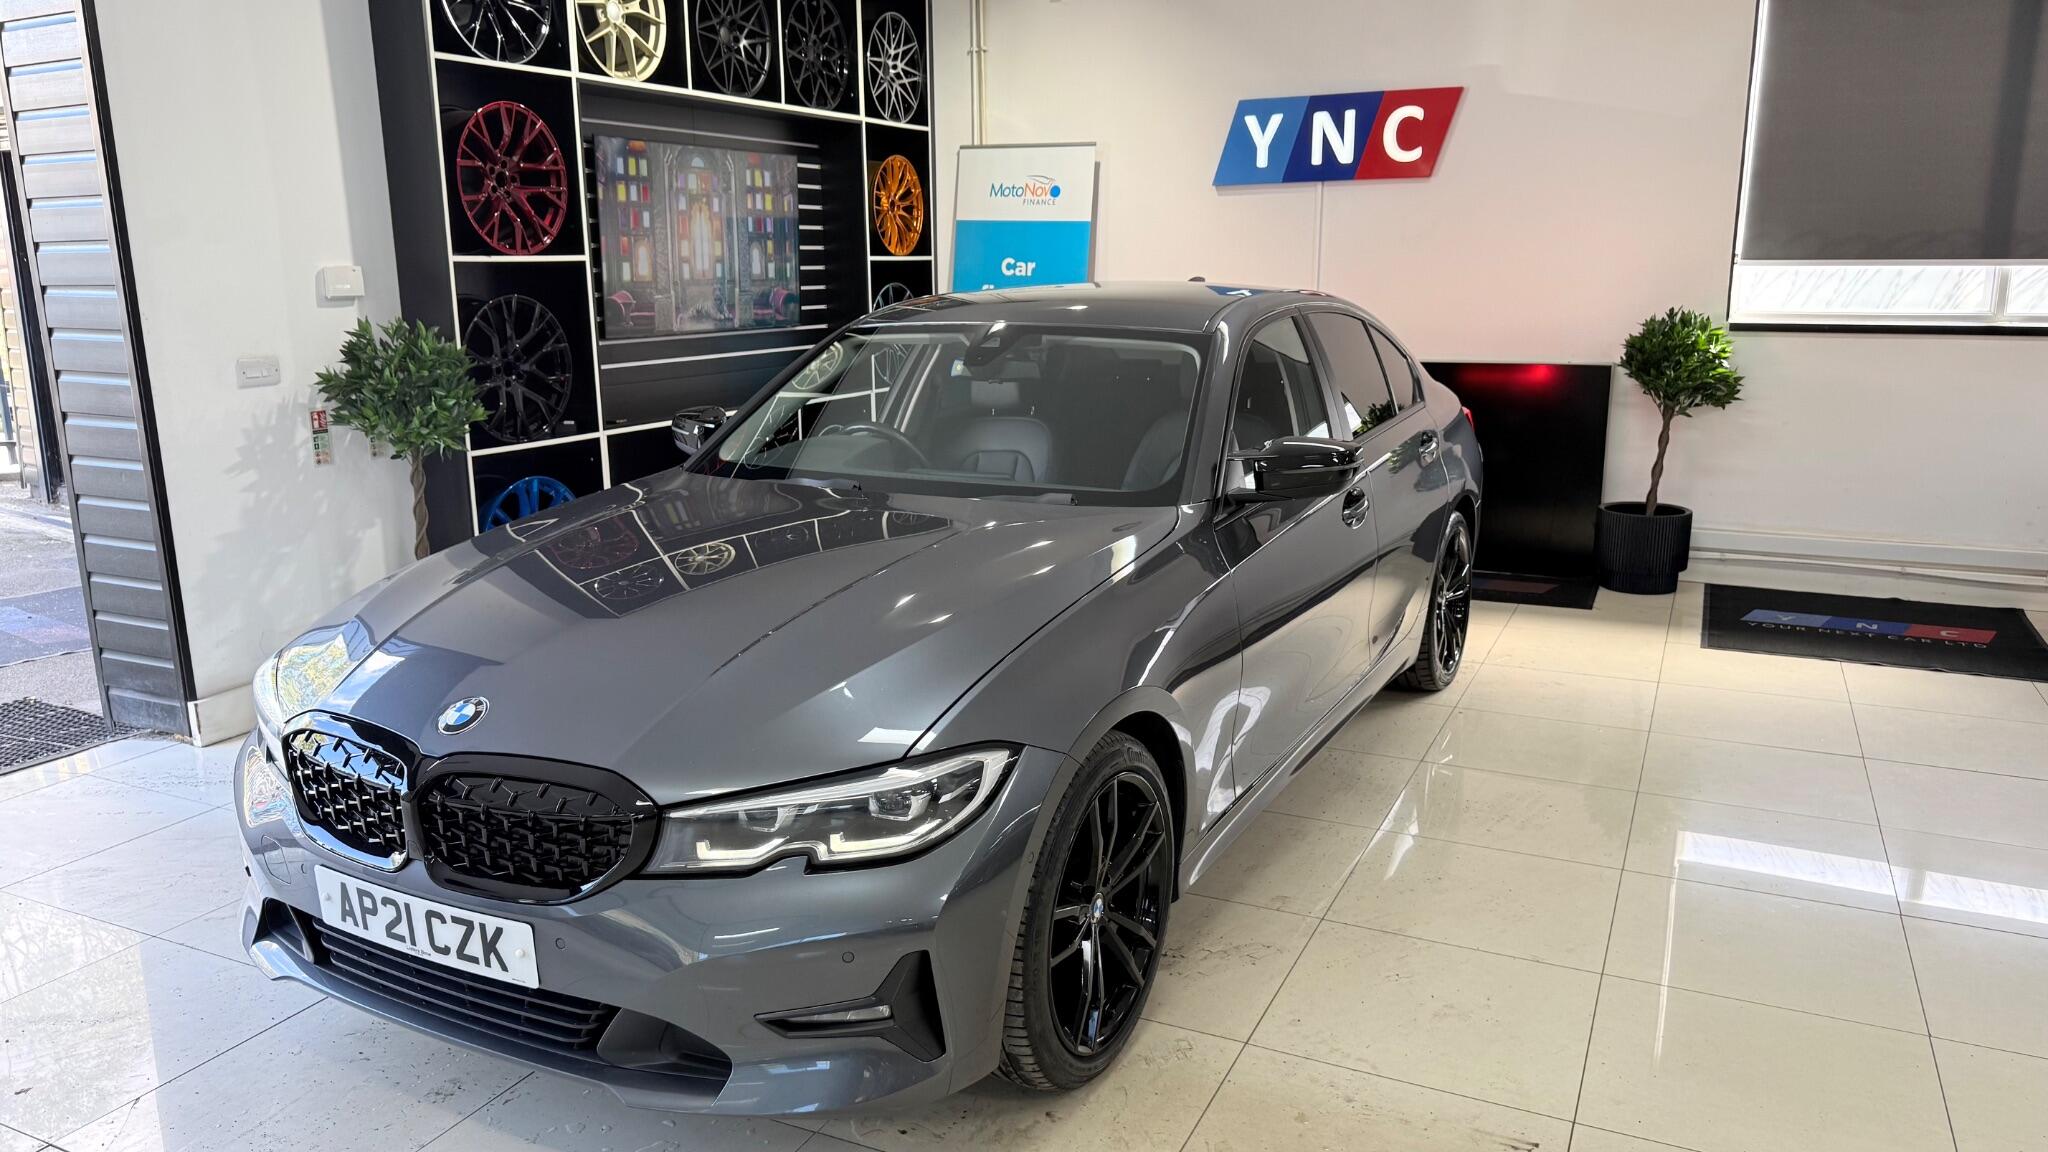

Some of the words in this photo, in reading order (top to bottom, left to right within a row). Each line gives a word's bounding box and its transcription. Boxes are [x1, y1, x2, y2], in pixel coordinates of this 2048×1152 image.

[1244, 105, 1425, 168] YNC
[989, 182, 1061, 198] MotoNovo
[1022, 198, 1057, 206] FINANCE
[1001, 257, 1036, 276] Car
[1748, 622, 1806, 631] YOUR
[1818, 628, 1875, 638] NEXT
[1887, 635, 1932, 643] CAR
[1944, 640, 1988, 649] LTD
[340, 881, 417, 947] AP21
[424, 909, 509, 973] CZK
